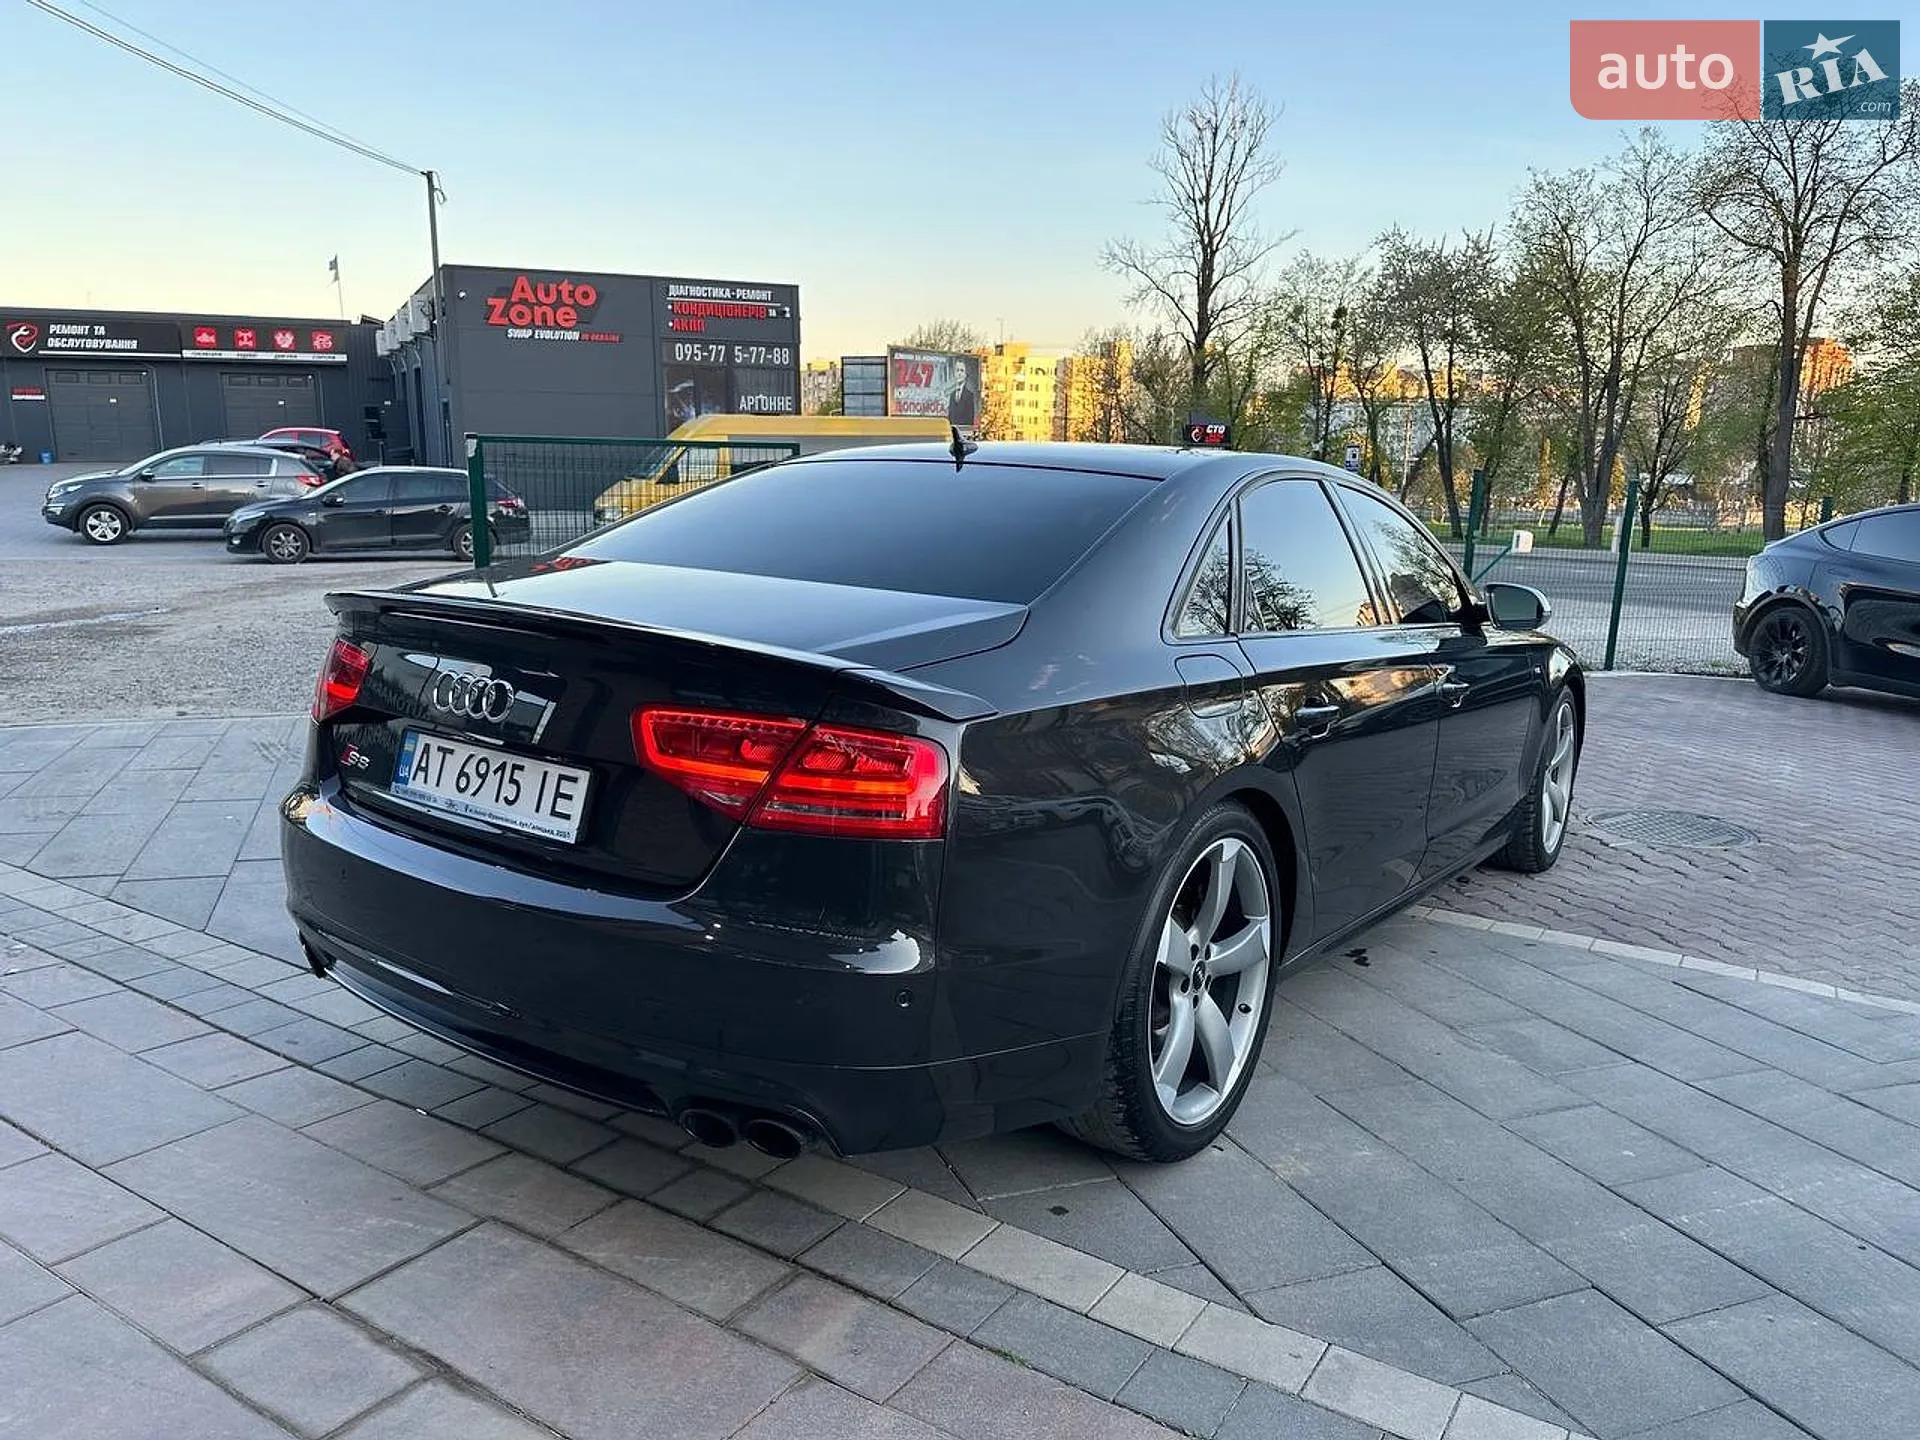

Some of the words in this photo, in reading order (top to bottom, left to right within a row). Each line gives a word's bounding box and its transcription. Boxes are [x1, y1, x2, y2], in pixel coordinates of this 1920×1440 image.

[510, 275, 598, 306] Auto
[487, 297, 577, 327] Zone
[673, 302, 767, 320] КОНДИЦІОНЕРІВ
[49, 324, 89, 335] РЕМОНТ
[93, 325, 106, 336] ТА
[507, 328, 533, 339] SWAP
[534, 329, 580, 341] EVOLUTION
[47, 337, 138, 350] ОБСЛУГОВУВАННЯ
[412, 743, 455, 788] AT
[455, 753, 525, 806] 6915
[535, 771, 580, 821] IE
